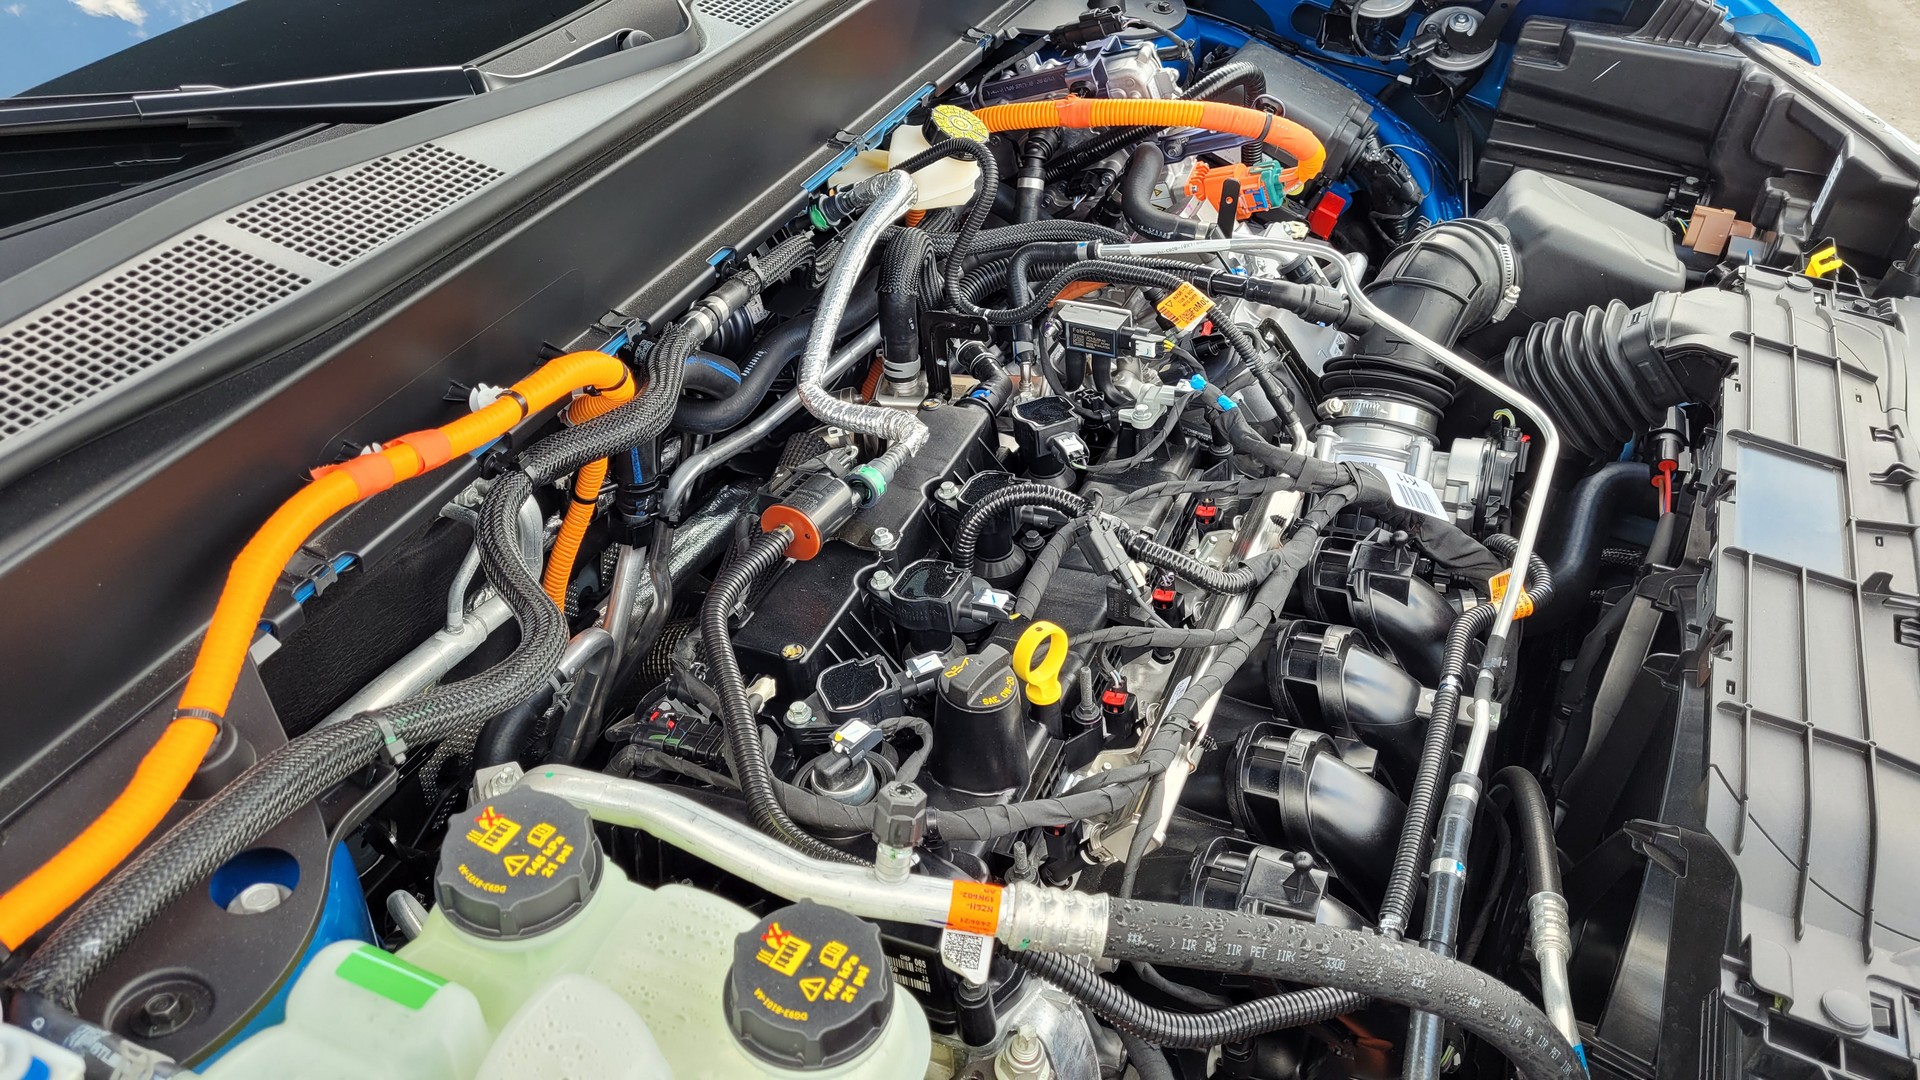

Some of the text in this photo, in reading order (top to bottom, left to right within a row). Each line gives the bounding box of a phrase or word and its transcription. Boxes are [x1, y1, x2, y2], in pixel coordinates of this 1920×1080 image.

[1189, 297, 1210, 315] FoMoC
[982, 676, 1015, 706] SAE 0W-20
[525, 835, 566, 876] 145 kPa
[541, 844, 574, 879] 21 psi
[914, 958, 927, 969] 065
[1249, 945, 1267, 960] PET
[1324, 956, 1347, 971] 3300
[823, 954, 860, 1001] 145 kPa
[840, 965, 870, 1004] 21 psi
[1548, 1046, 1562, 1060] PET
